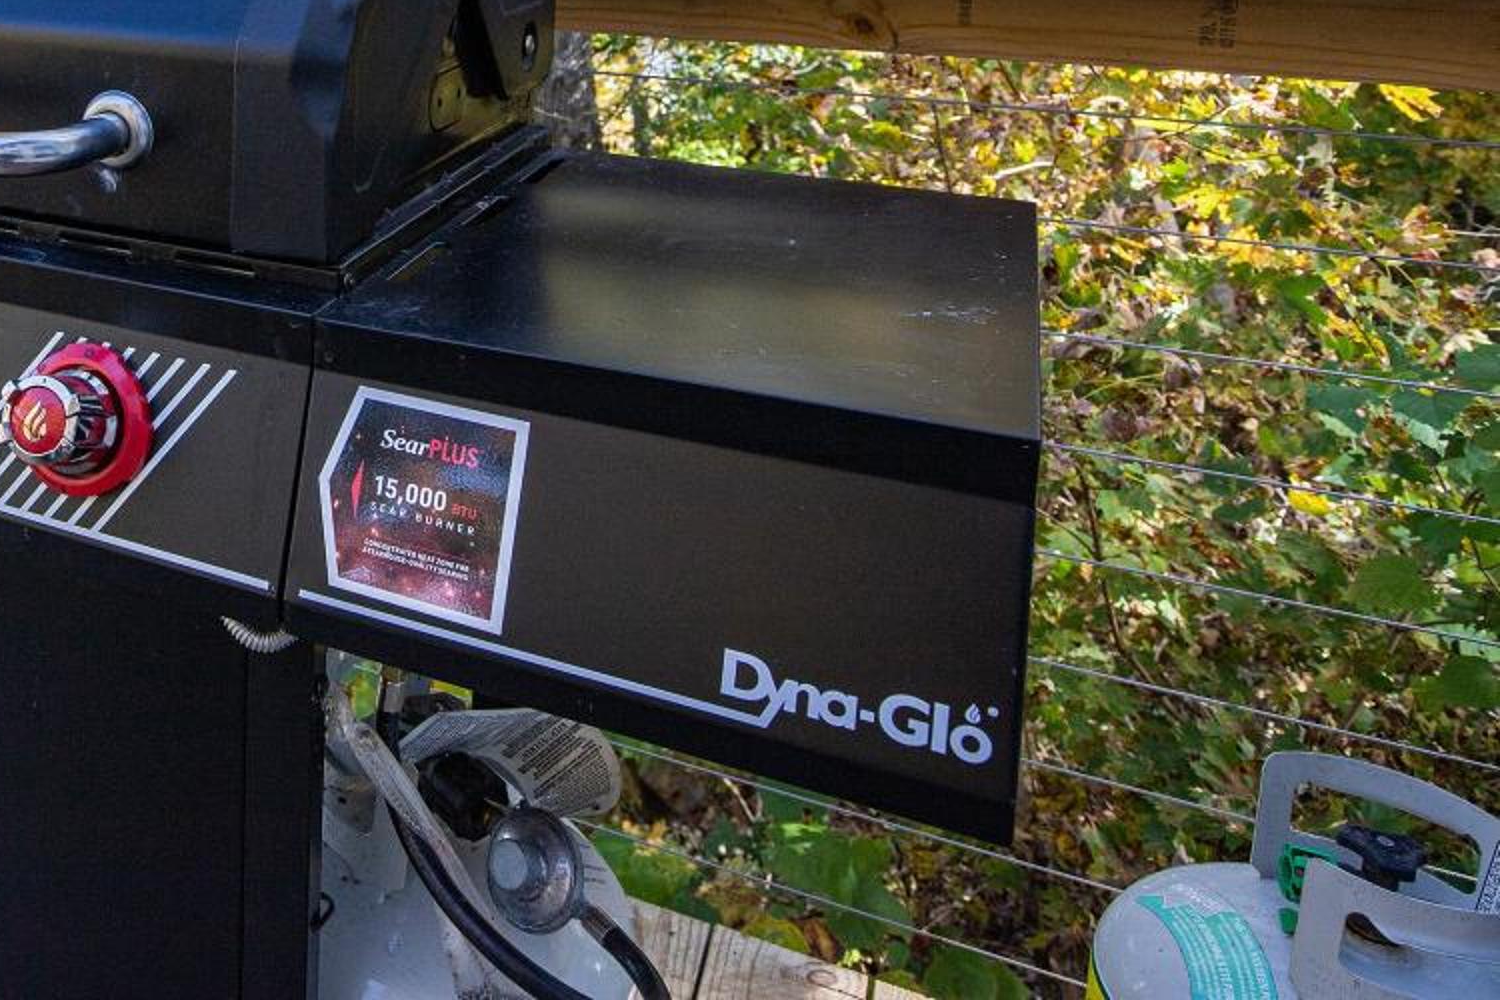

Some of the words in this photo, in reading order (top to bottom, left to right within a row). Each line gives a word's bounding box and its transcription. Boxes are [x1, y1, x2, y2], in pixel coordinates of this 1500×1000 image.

[375, 475, 447, 512] 15,000
[451, 503, 478, 520] BTU
[369, 501, 408, 517] SEAR
[414, 512, 476, 536] BURNER
